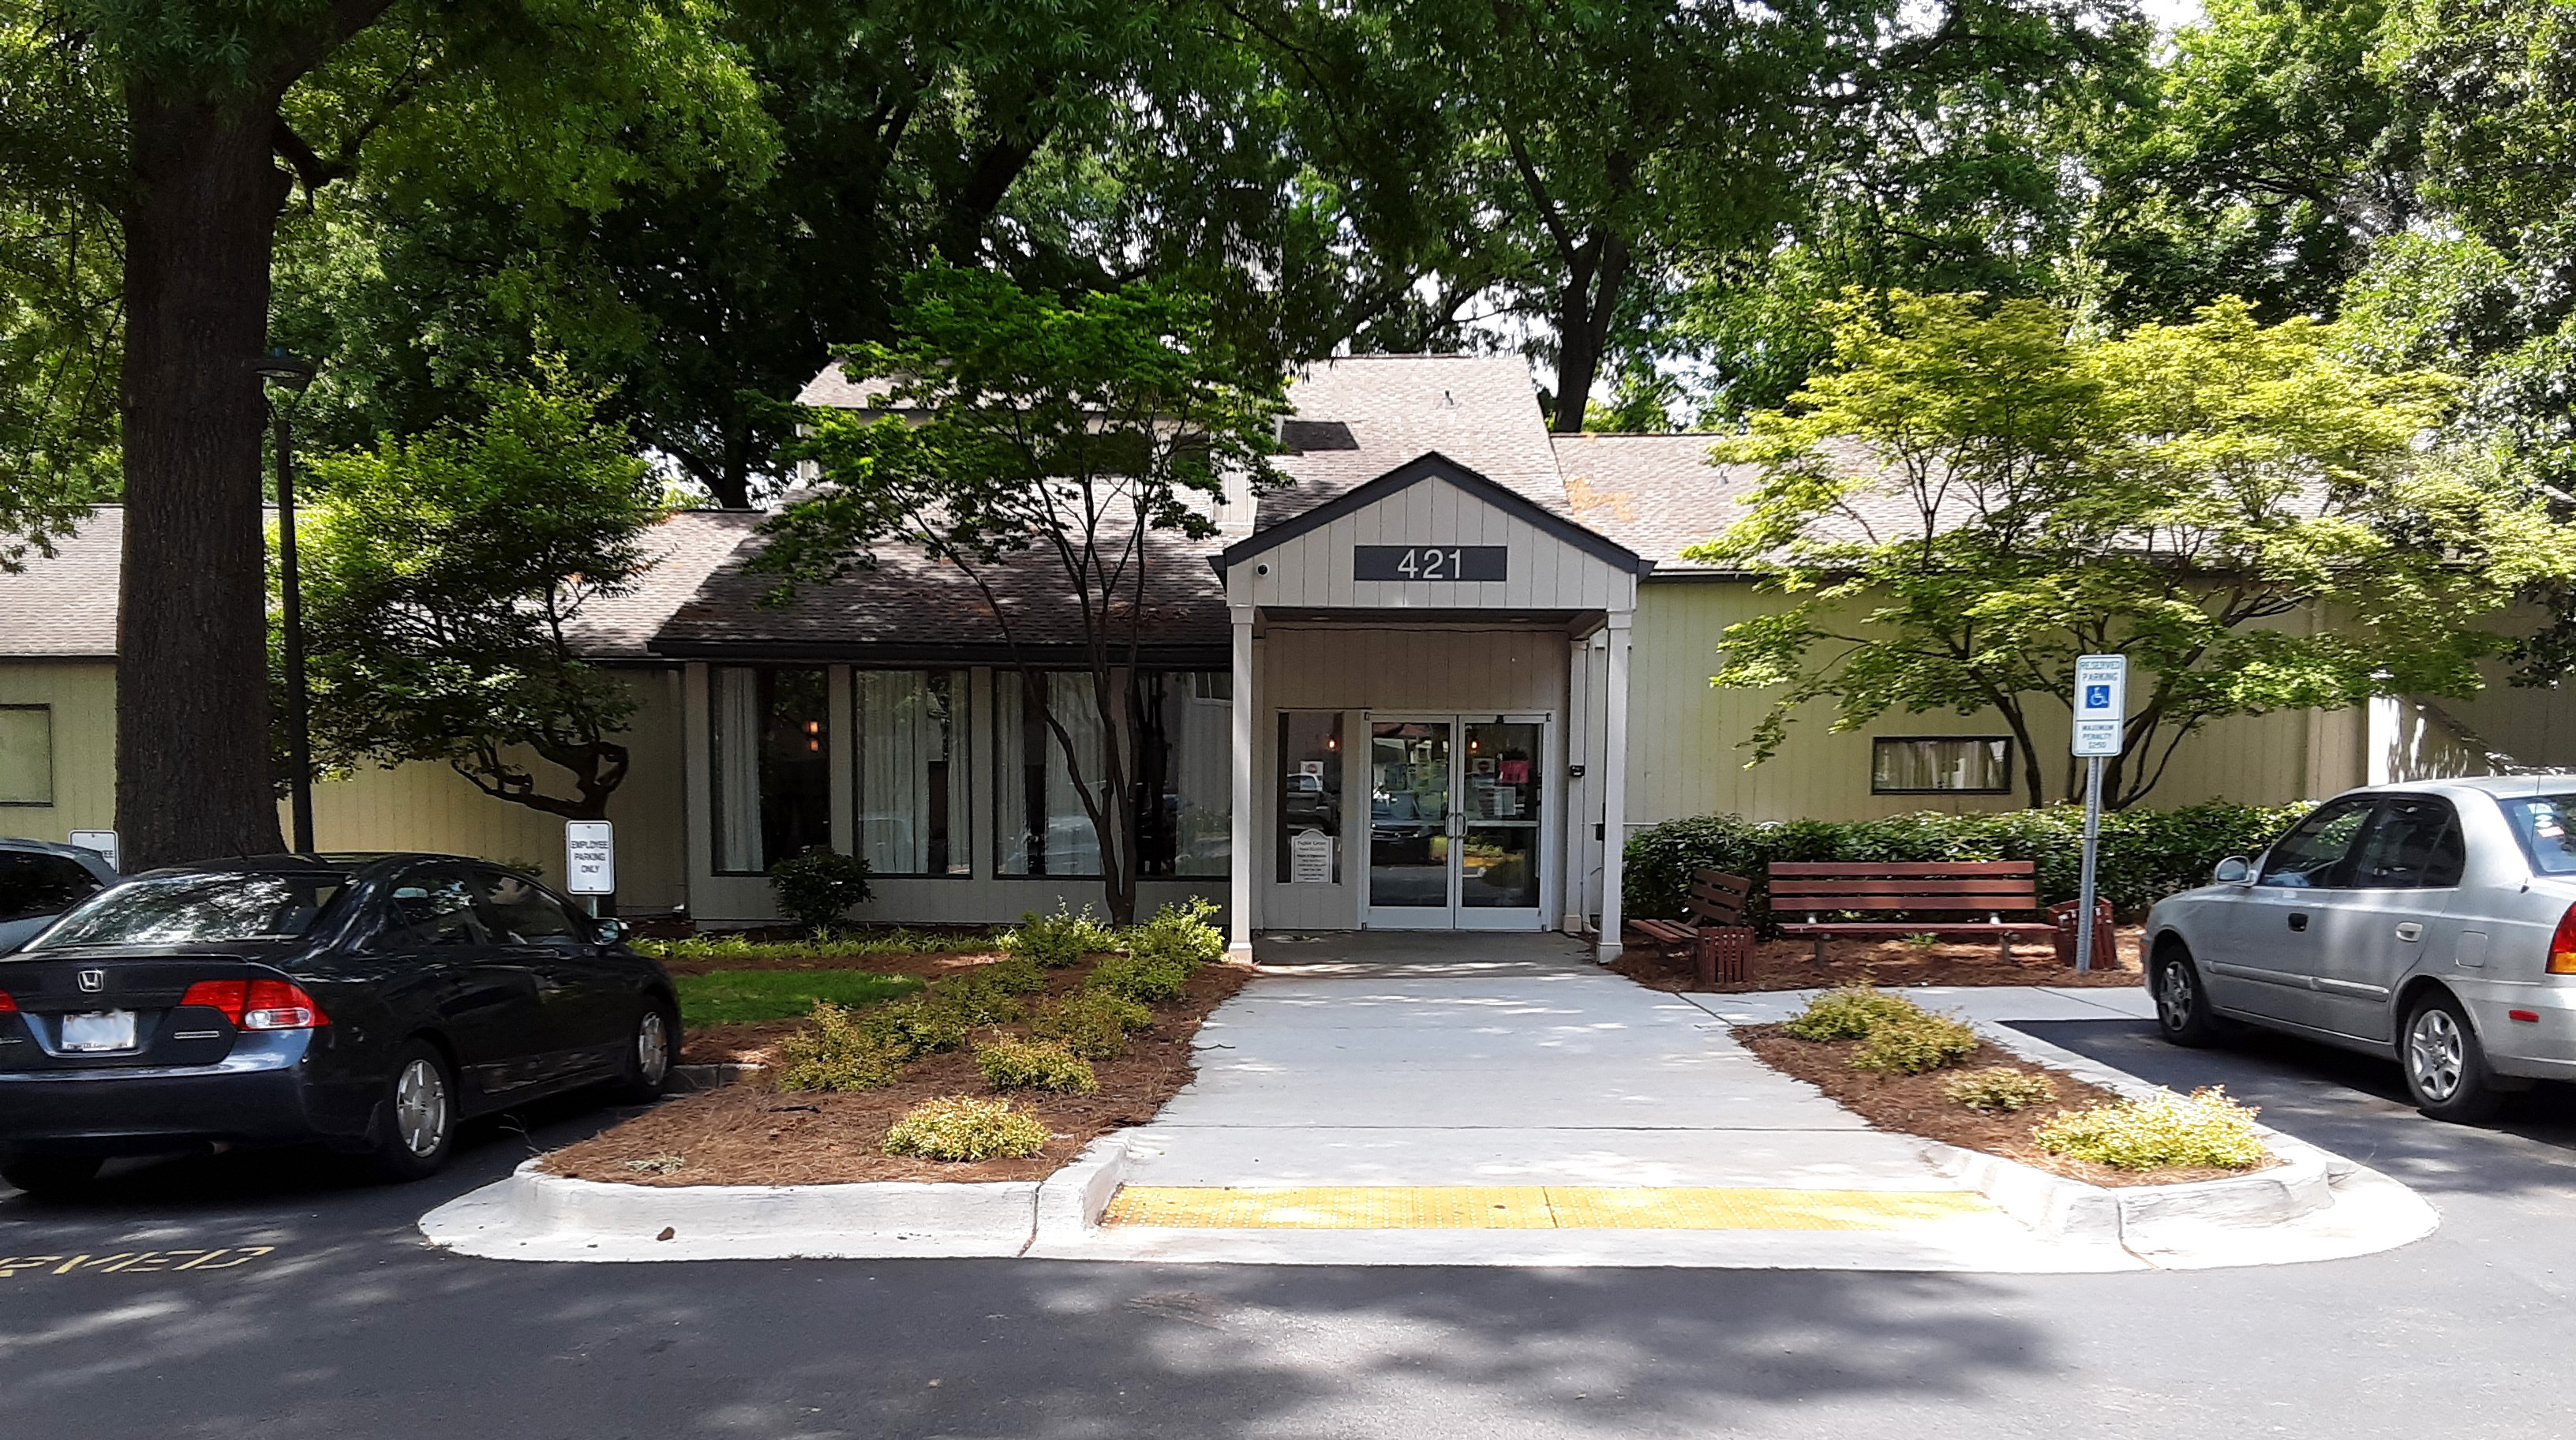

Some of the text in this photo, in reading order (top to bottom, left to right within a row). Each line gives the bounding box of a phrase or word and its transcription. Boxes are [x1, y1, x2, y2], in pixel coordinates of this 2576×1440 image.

[1397, 548, 1462, 579] 421
[2080, 661, 2120, 669] RESERVED
[2082, 672, 2118, 681] PARKING
[571, 840, 608, 849] EMPLOYEE
[575, 853, 606, 861] PARKING
[581, 864, 600, 873] ONLY
